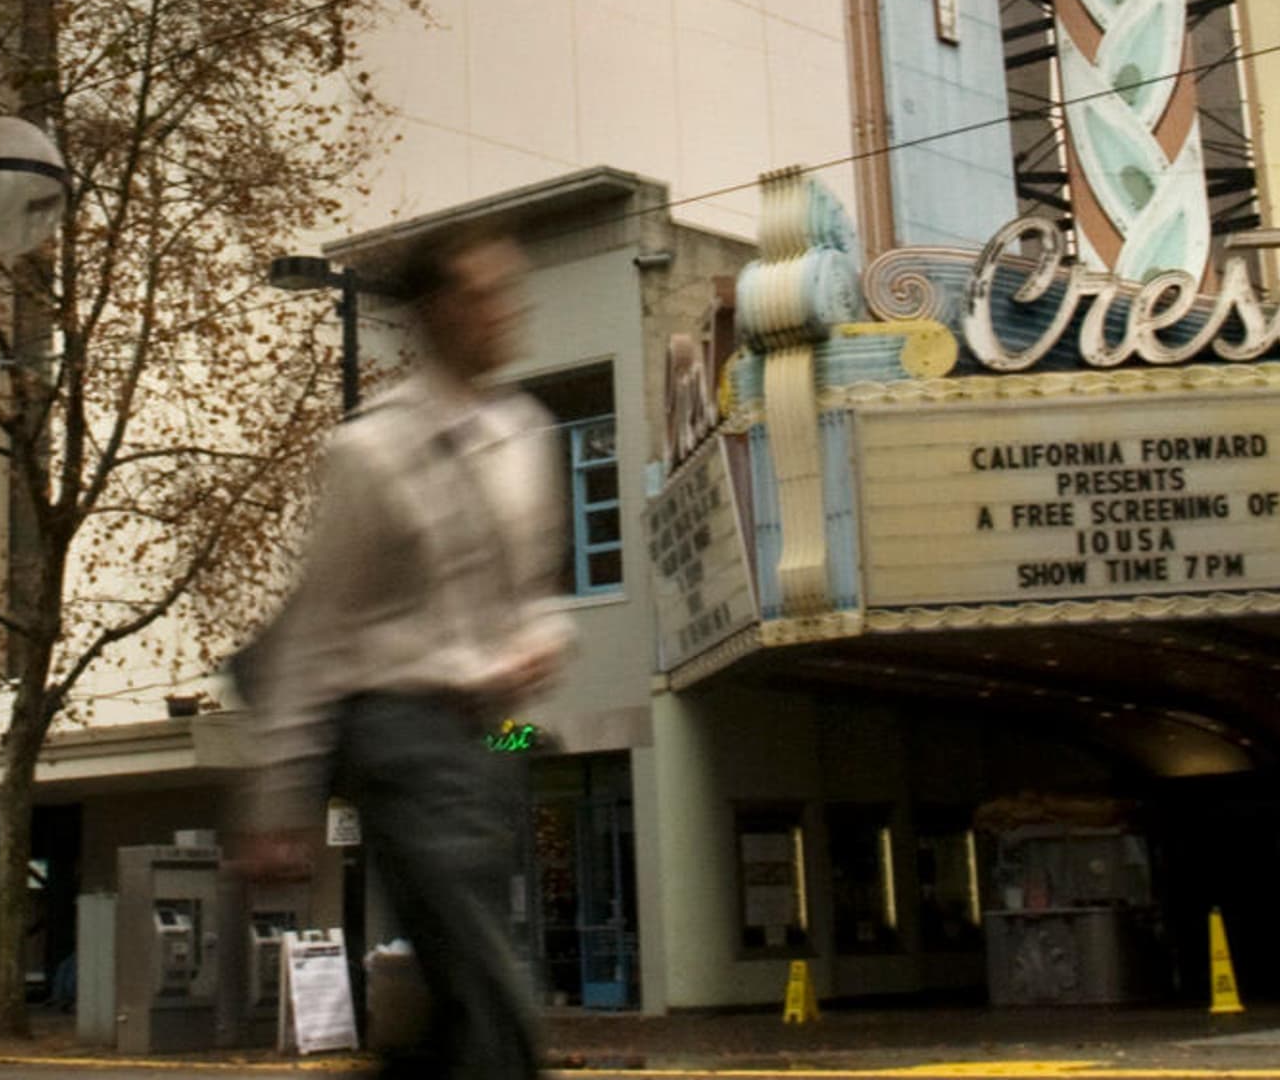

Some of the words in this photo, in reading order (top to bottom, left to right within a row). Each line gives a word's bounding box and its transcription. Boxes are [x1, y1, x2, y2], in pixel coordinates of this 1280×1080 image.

[971, 441, 1124, 470] CALIFORNIA
[1141, 434, 1268, 462] FORWARD
[1057, 468, 1185, 496] PRESENTS
[976, 506, 994, 529] A
[1012, 502, 1075, 528] FREE
[1091, 494, 1229, 524] SCREENING
[1248, 492, 1280, 517] OF
[1017, 561, 1087, 588] SHOW
[1105, 557, 1168, 583] TIME
